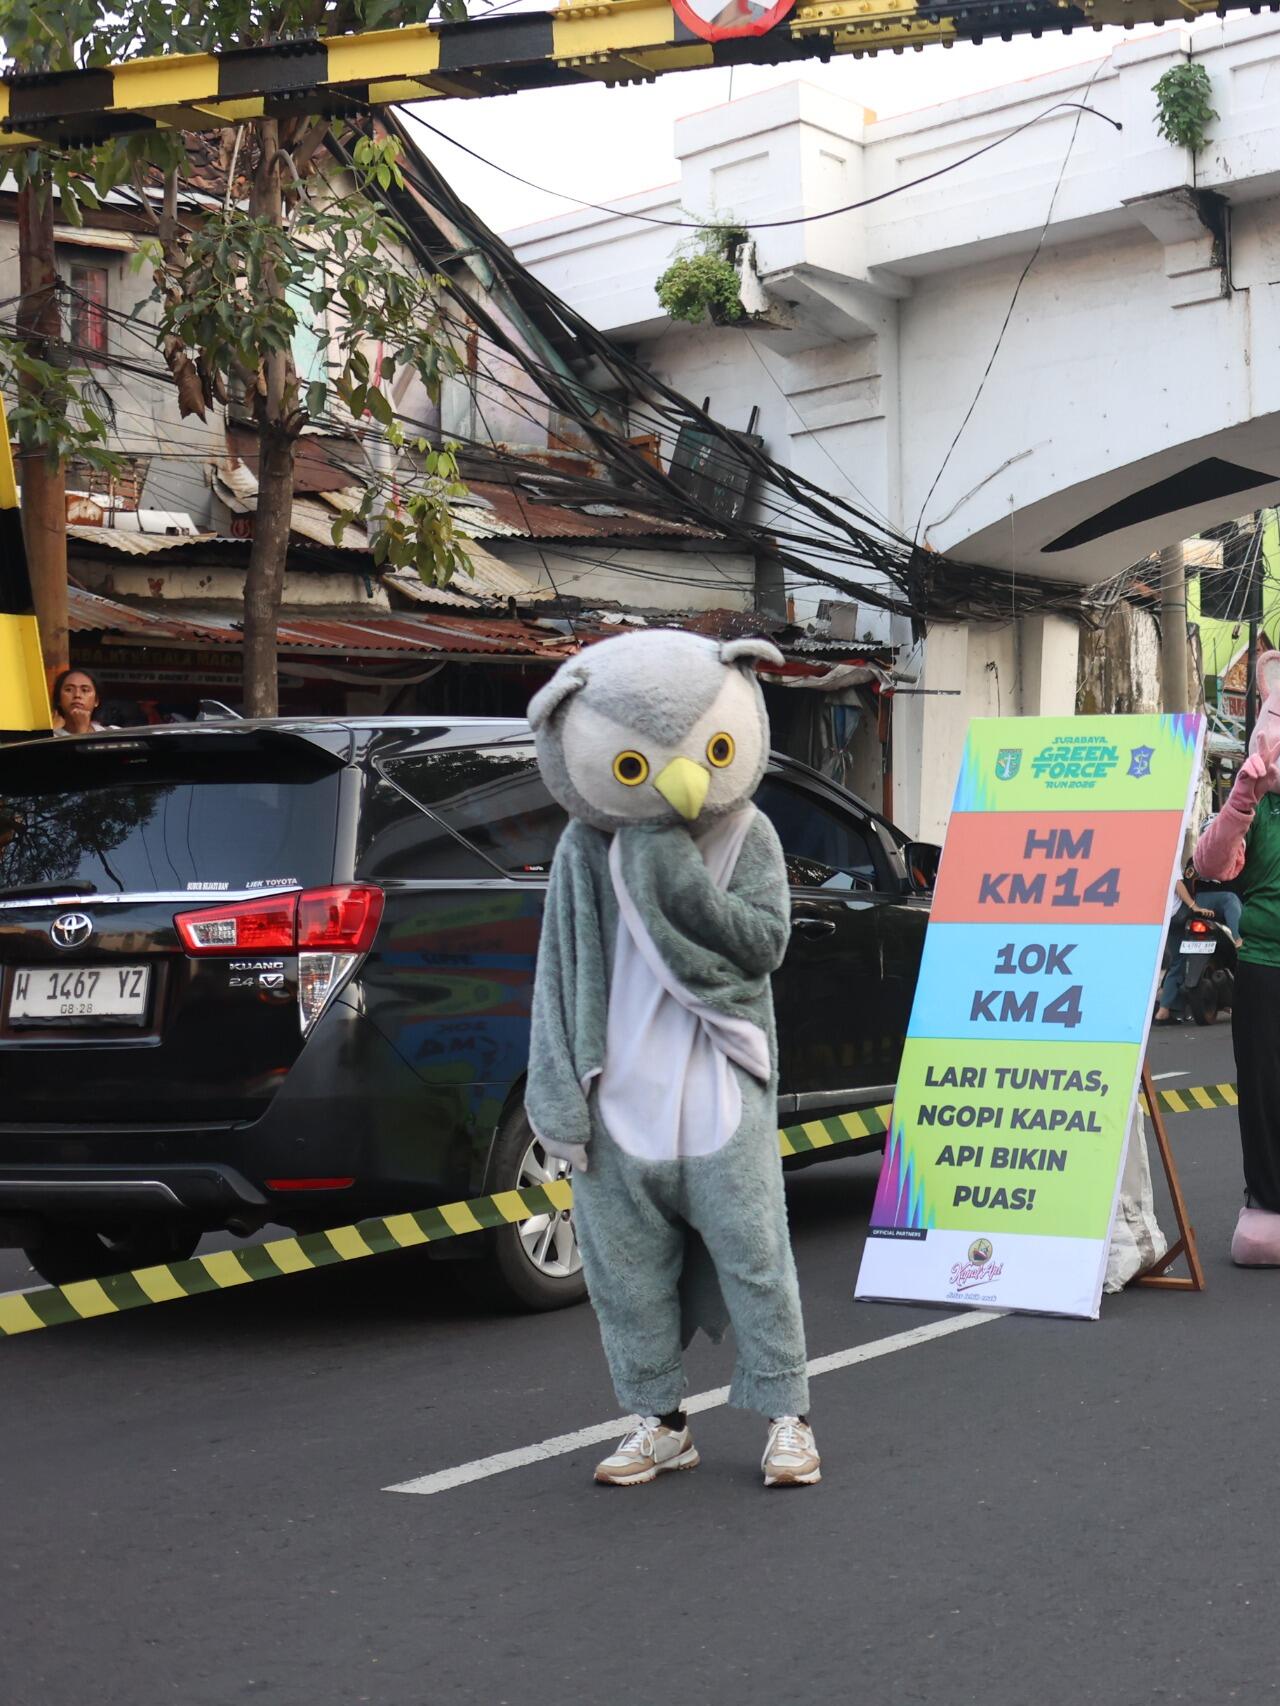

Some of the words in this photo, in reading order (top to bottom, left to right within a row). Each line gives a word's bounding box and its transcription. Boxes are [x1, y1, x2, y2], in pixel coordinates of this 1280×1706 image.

[1052, 736, 1108, 745] SURABAYA
[1033, 746, 1119, 763] GREEN
[1031, 762, 1117, 779] FORCE
[1045, 781, 1068, 789] RUN
[1023, 829, 1095, 860] HM
[265, 878, 298, 887] TOYOTA
[978, 873, 1047, 905] KM
[1051, 868, 1121, 907] 14
[994, 943, 1079, 975] 10K
[16, 973, 31, 1001] W
[46, 971, 101, 1000] 1467
[118, 970, 143, 998] YZ
[969, 990, 1039, 1022] KM
[1041, 985, 1083, 1028] 4
[924, 1066, 987, 1088] LARI
[995, 1068, 1109, 1097] TUNTAS,
[917, 1105, 1004, 1128] NGOPI
[1010, 1108, 1102, 1133] KAPAL
[935, 1145, 984, 1168] API
[990, 1147, 1068, 1172] BIKIN
[952, 1185, 1037, 1211] PUAS!
